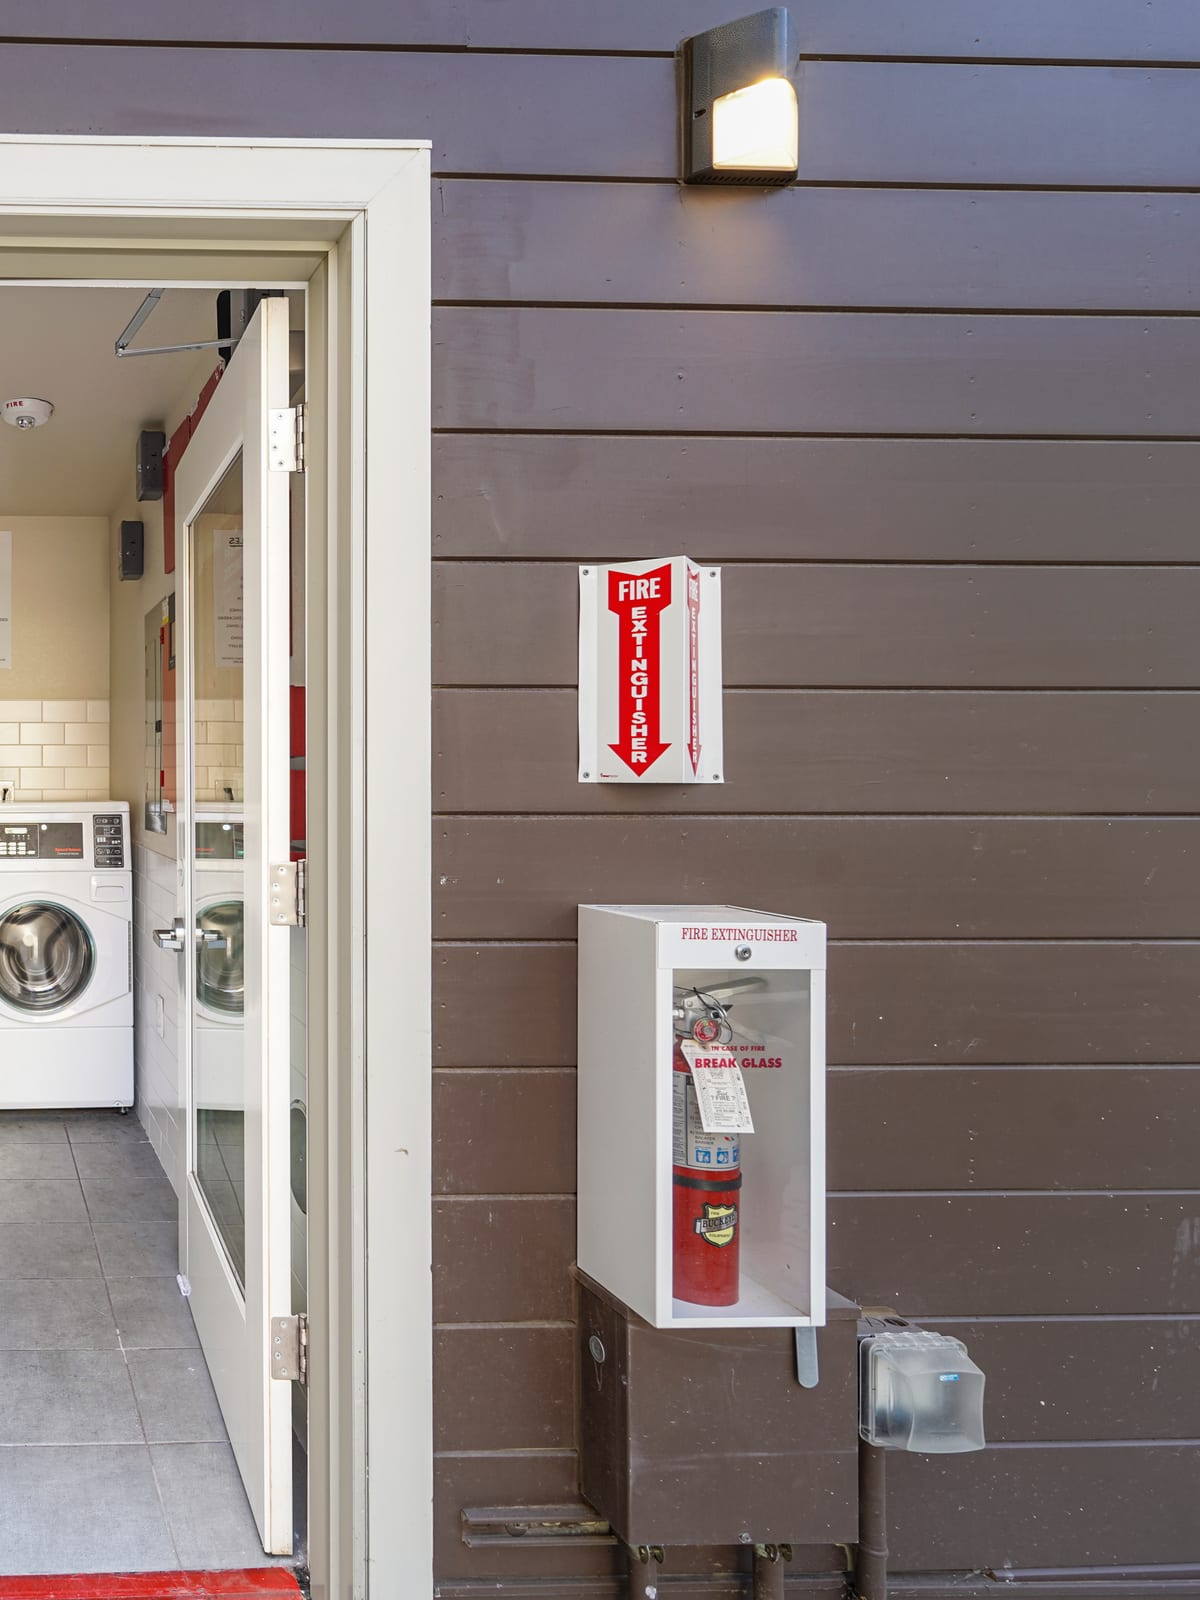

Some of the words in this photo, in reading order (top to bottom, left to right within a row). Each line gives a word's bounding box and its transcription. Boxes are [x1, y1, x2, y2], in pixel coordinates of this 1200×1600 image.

[6, 401, 24, 409] FIRE
[618, 577, 661, 602] FIRE
[630, 606, 648, 764] EXTINGUISHER
[681, 927, 708, 940] FIRE
[711, 928, 798, 942] EXTINGUISHER
[695, 1058, 737, 1068] BREAK
[741, 1058, 782, 1068] GLASS
[702, 1213, 736, 1228] BUCKEYE
